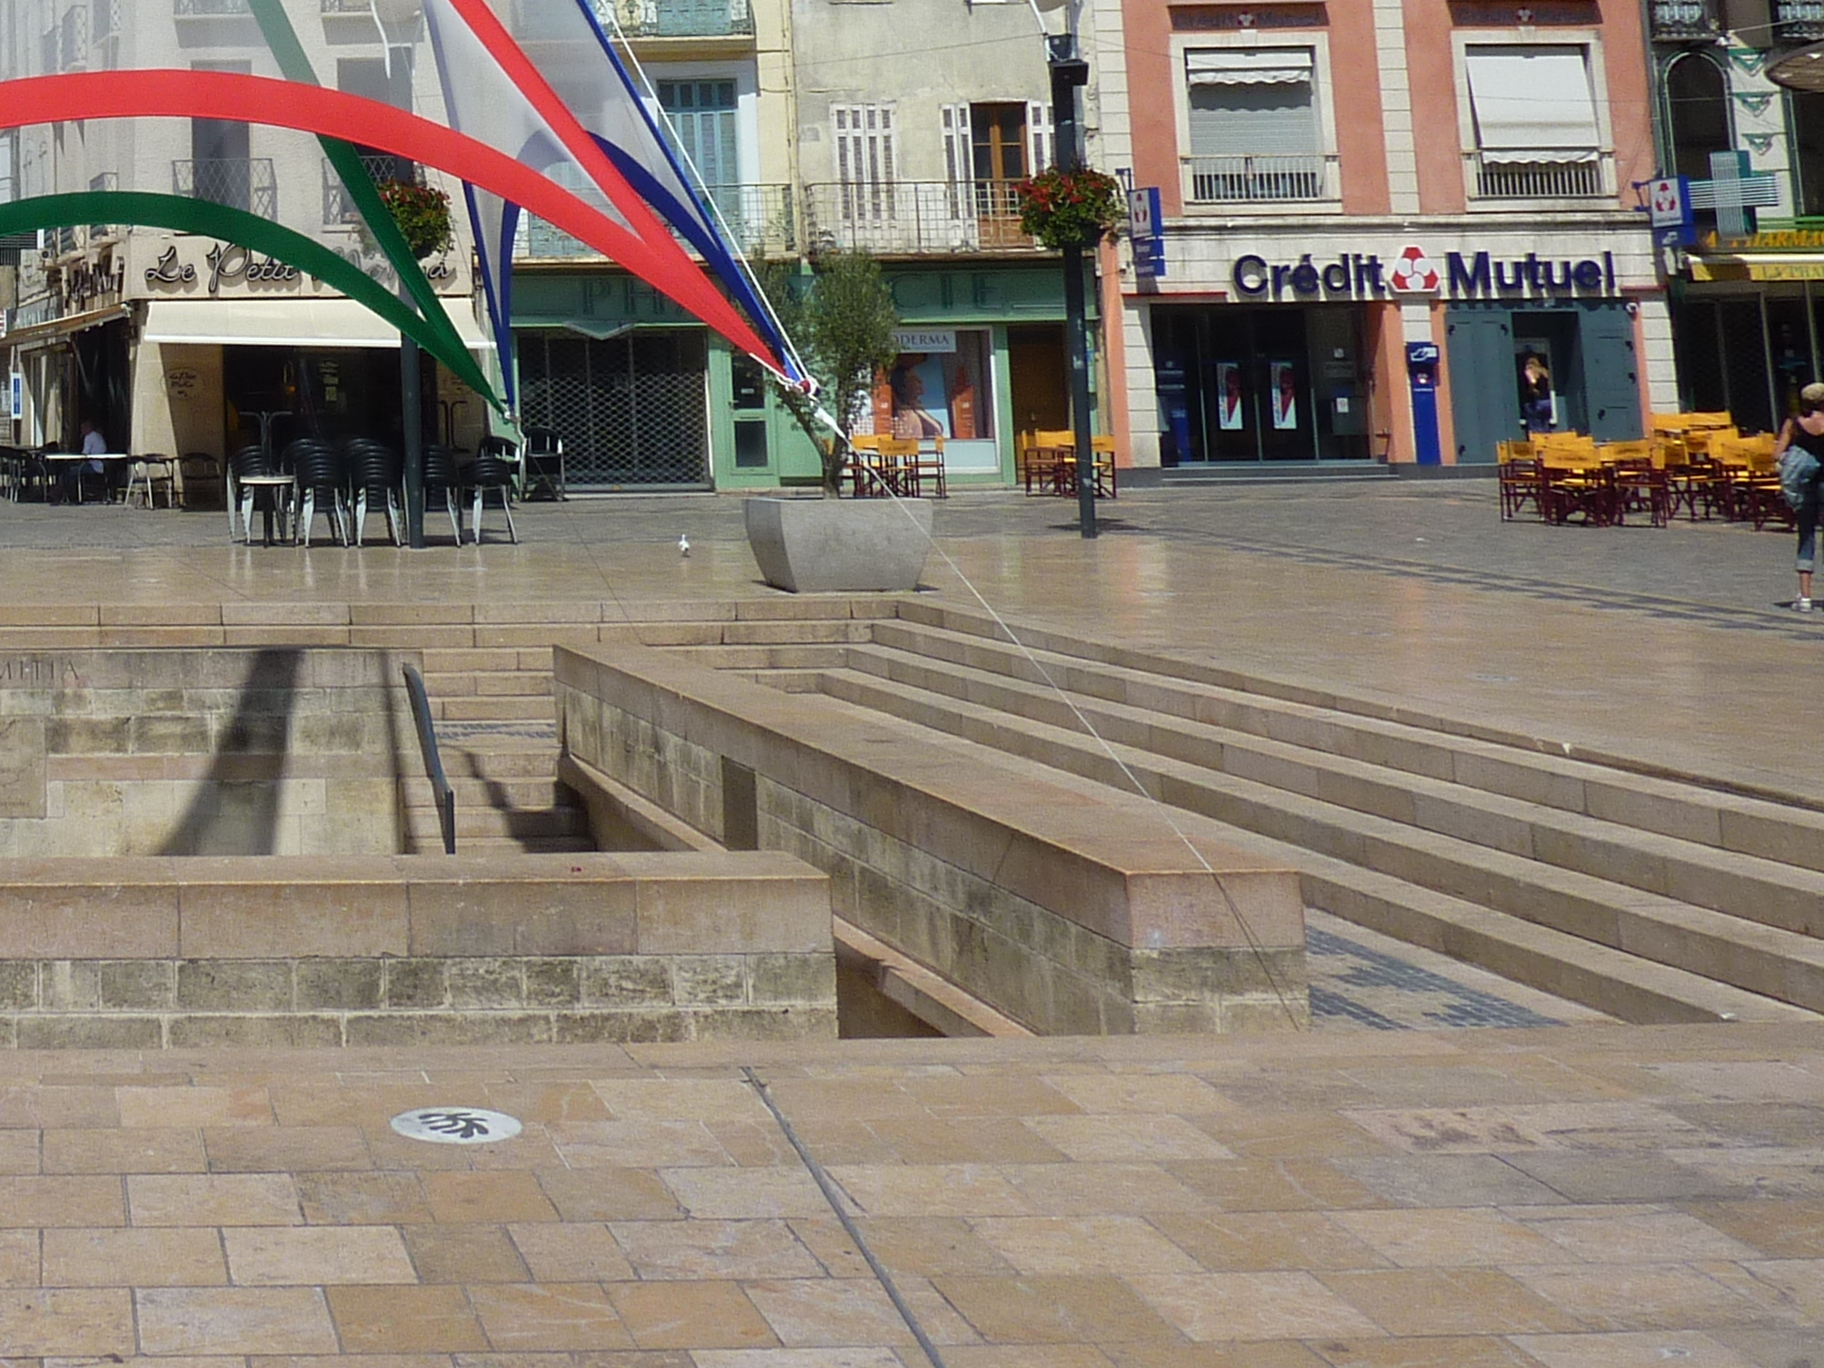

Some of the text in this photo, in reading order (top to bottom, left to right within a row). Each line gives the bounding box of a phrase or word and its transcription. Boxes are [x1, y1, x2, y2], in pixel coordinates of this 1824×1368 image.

[145, 235, 198, 282] Le
[205, 233, 300, 292] Petit
[1233, 250, 1616, 294] Crédit Mutuel
